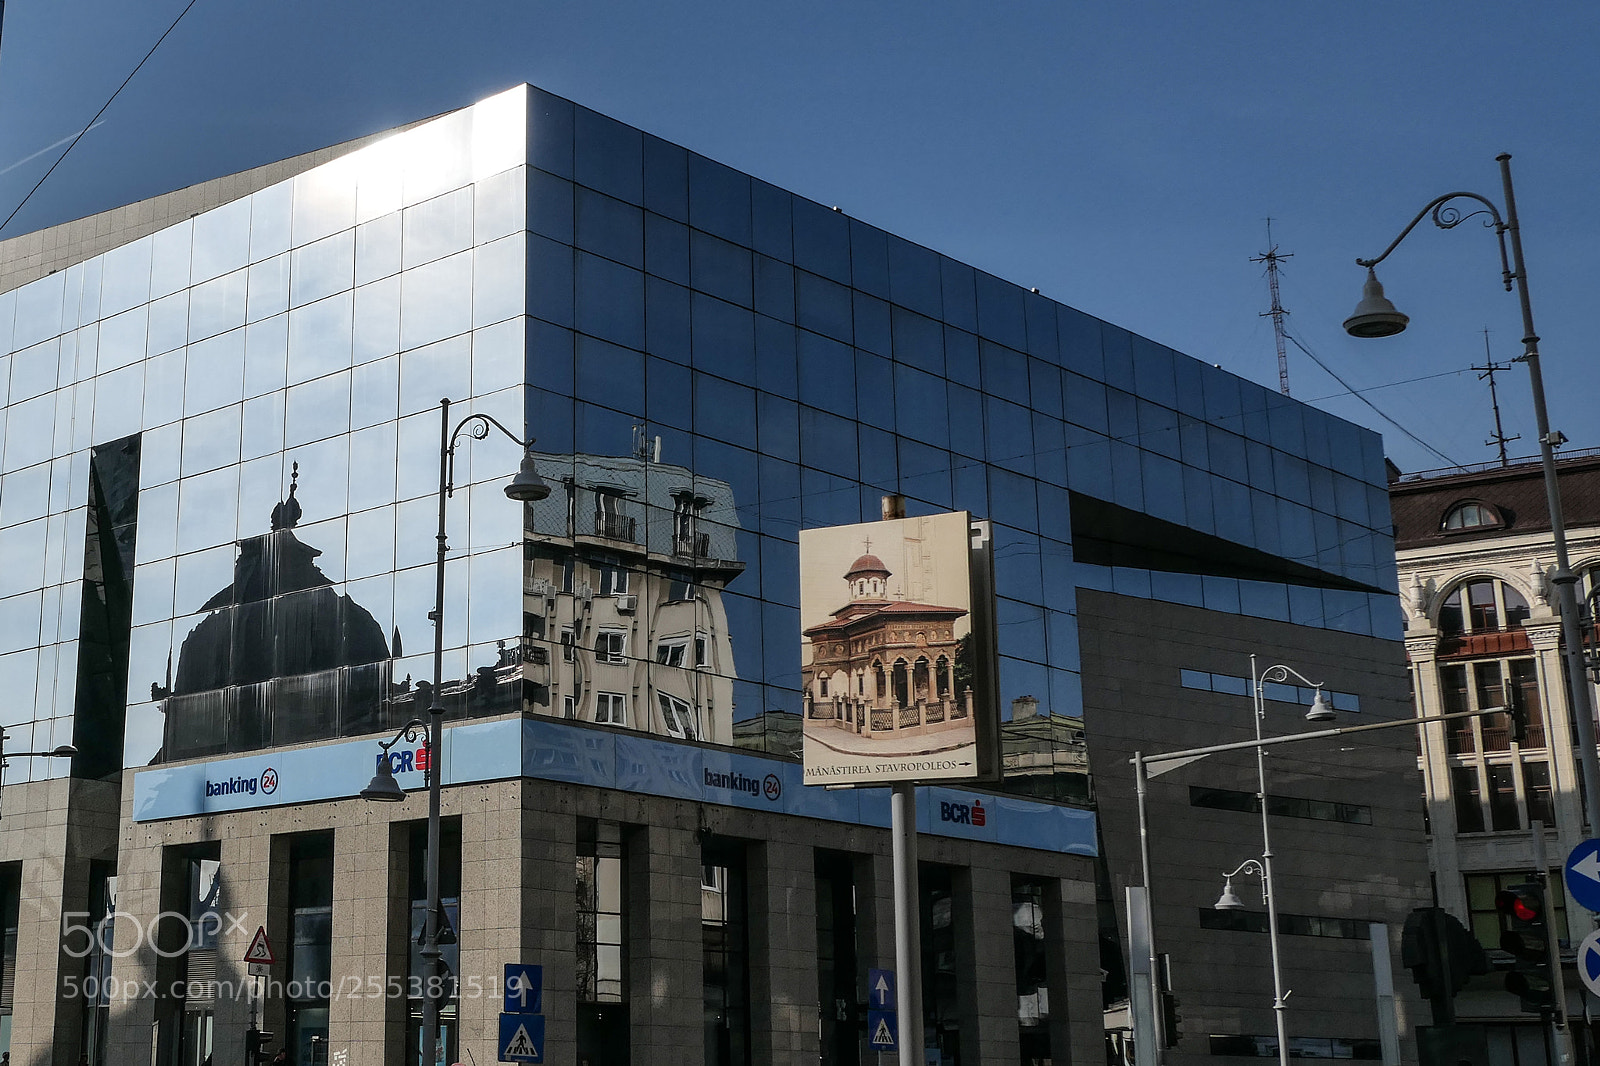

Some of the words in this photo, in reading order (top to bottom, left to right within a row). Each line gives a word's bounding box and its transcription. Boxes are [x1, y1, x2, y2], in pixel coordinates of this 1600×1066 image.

[875, 760, 957, 774] STAVROPOLEOS
[206, 776, 258, 797] banking
[263, 775, 275, 788] 24
[704, 767, 760, 797] banking
[766, 781, 778, 795] 24
[940, 801, 971, 825] BCR
